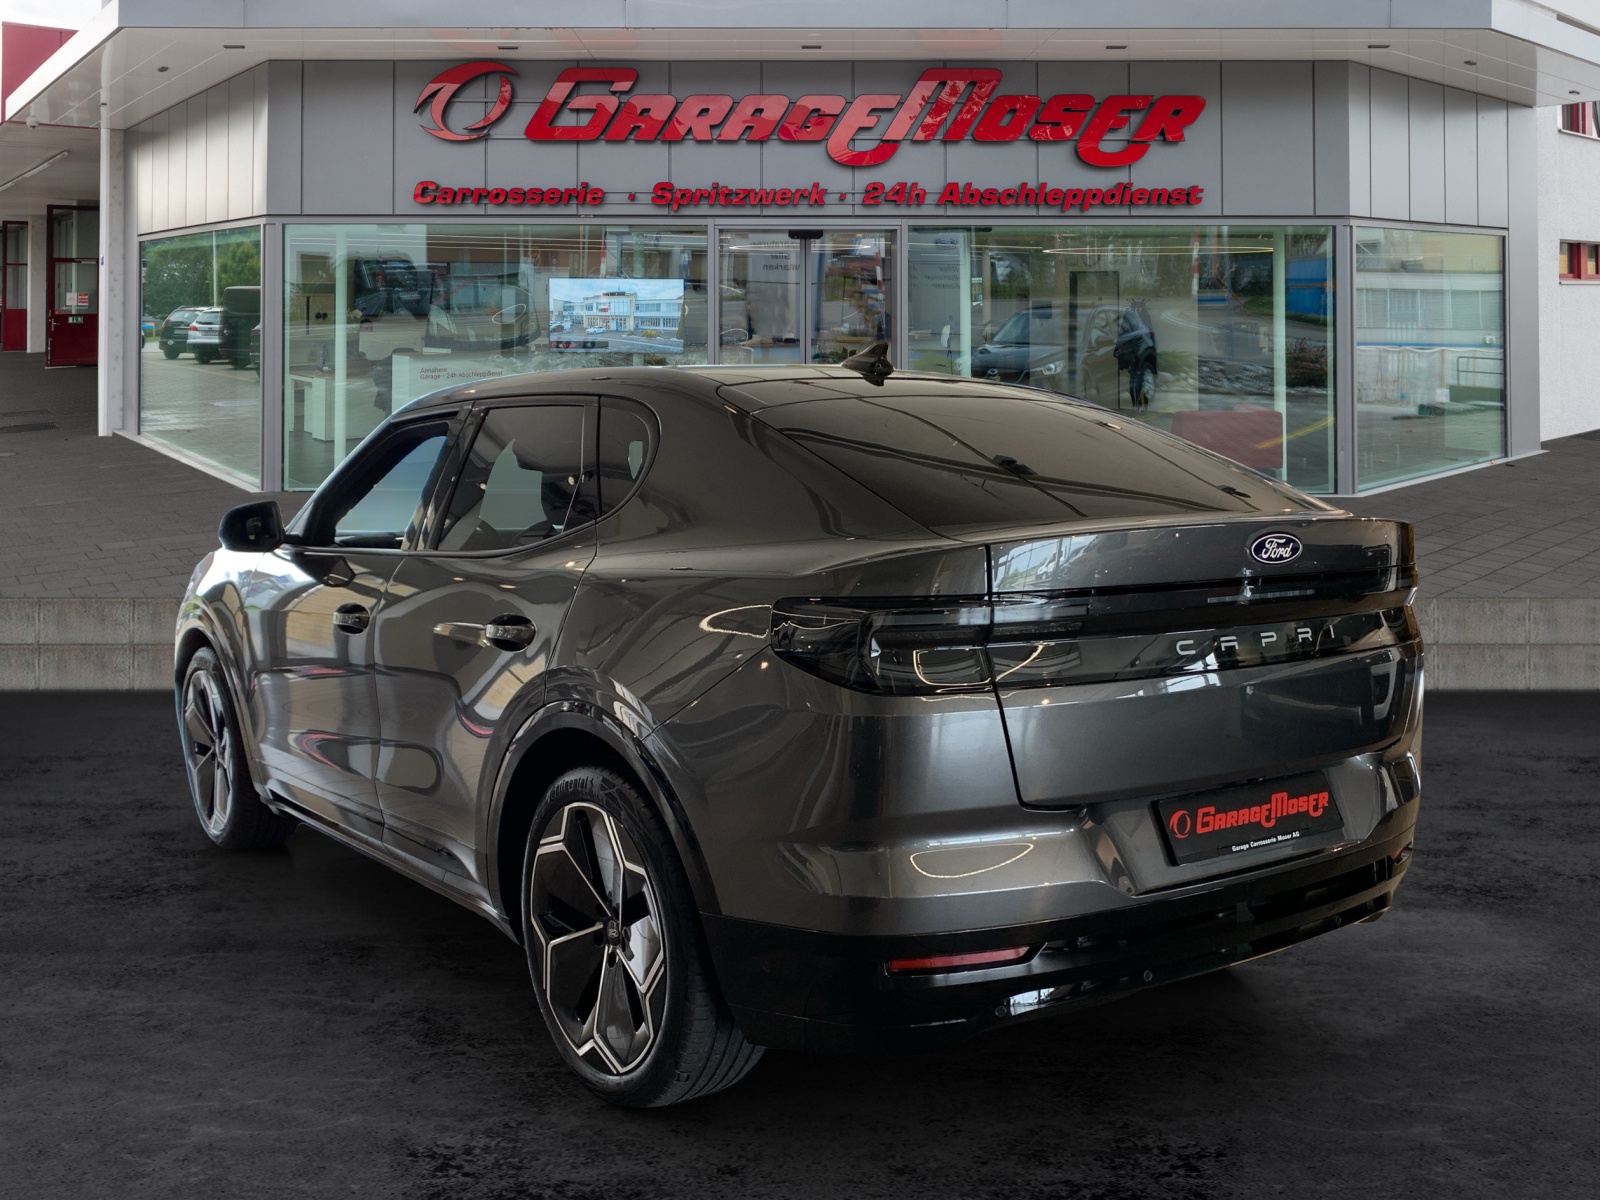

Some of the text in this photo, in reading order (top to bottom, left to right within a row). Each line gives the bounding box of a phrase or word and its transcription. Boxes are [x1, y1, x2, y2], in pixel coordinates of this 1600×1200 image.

[413, 180, 1205, 212] Carrosserie Spritzwerk 24h Abschleppdienst
[458, 370, 503, 378] Abschleppdienst
[1261, 538, 1294, 559] Ford
[1175, 624, 1335, 656] CAPRI
[1231, 844, 1249, 852] Garage
[1250, 837, 1276, 847] Carrosserie
